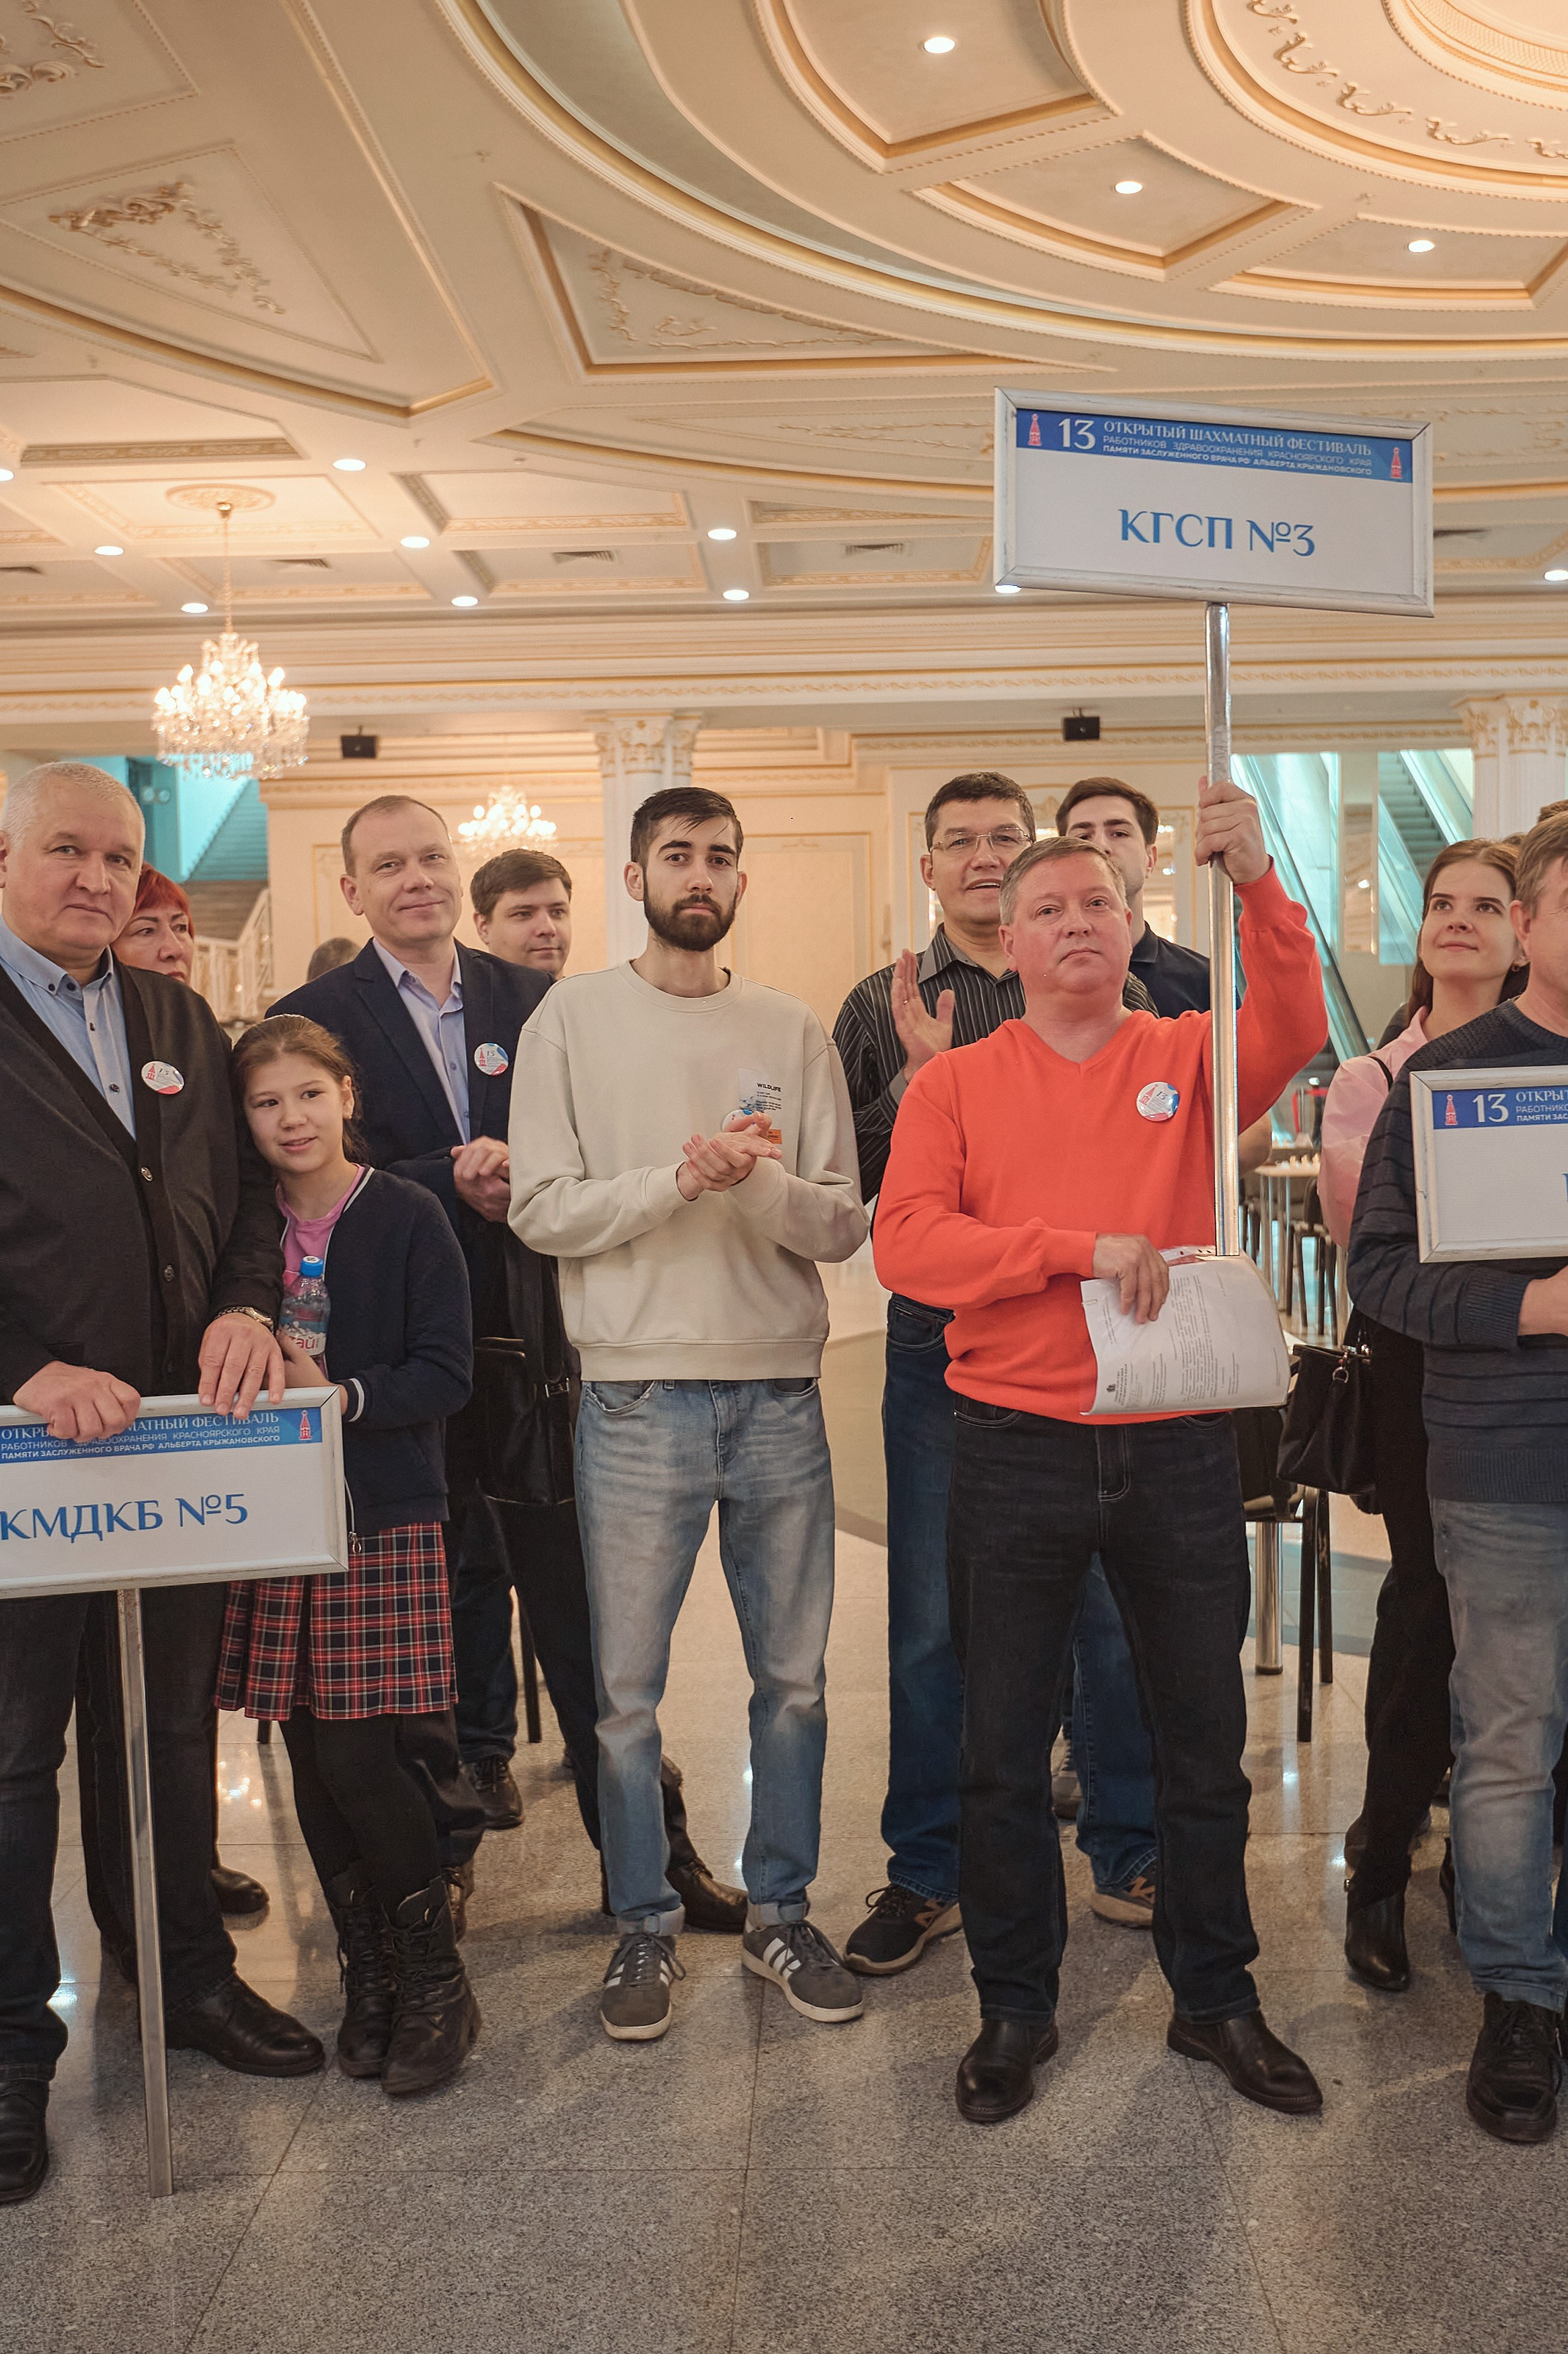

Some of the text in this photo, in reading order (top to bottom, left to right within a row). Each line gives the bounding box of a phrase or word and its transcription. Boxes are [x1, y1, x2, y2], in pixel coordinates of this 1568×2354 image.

[1058, 418, 1372, 455] 13 ОТКРЫТЫЙ ШАХМАТНЫЙ ФЕСТИВАЛЬ
[1103, 436, 1167, 449] РАБОТНИКОВ
[1173, 443, 1263, 457] ЗДРАВООХРАНЕНИЯ
[1268, 451, 1343, 465] КРАСНОЯРСКОГО
[1103, 445, 1138, 455] ПАМЯТИ
[1141, 449, 1209, 460] ЗАСЛУЖЕННОГО
[1212, 455, 1237, 463] ВРАЧА
[1253, 459, 1295, 469] АЛЬБЕРТА
[1118, 509, 1315, 557] КГСП №3
[757, 1083, 781, 1092] WILDLIFE
[1473, 1094, 1510, 1123] 13
[1, 1440, 67, 1450] РАБОТНИКОВ
[173, 1428, 251, 1439] КРАСНОЯРСКОГО
[42, 1446, 112, 1457] ЗАСЛУЖЕННОГО
[114, 1443, 141, 1451] ВРАЧА
[158, 1441, 201, 1449] АЛЬБЕРТА
[203, 1435, 280, 1445] КРЫЖАНОВСКОГО
[0, 1494, 248, 1544] КМДКБ №5
